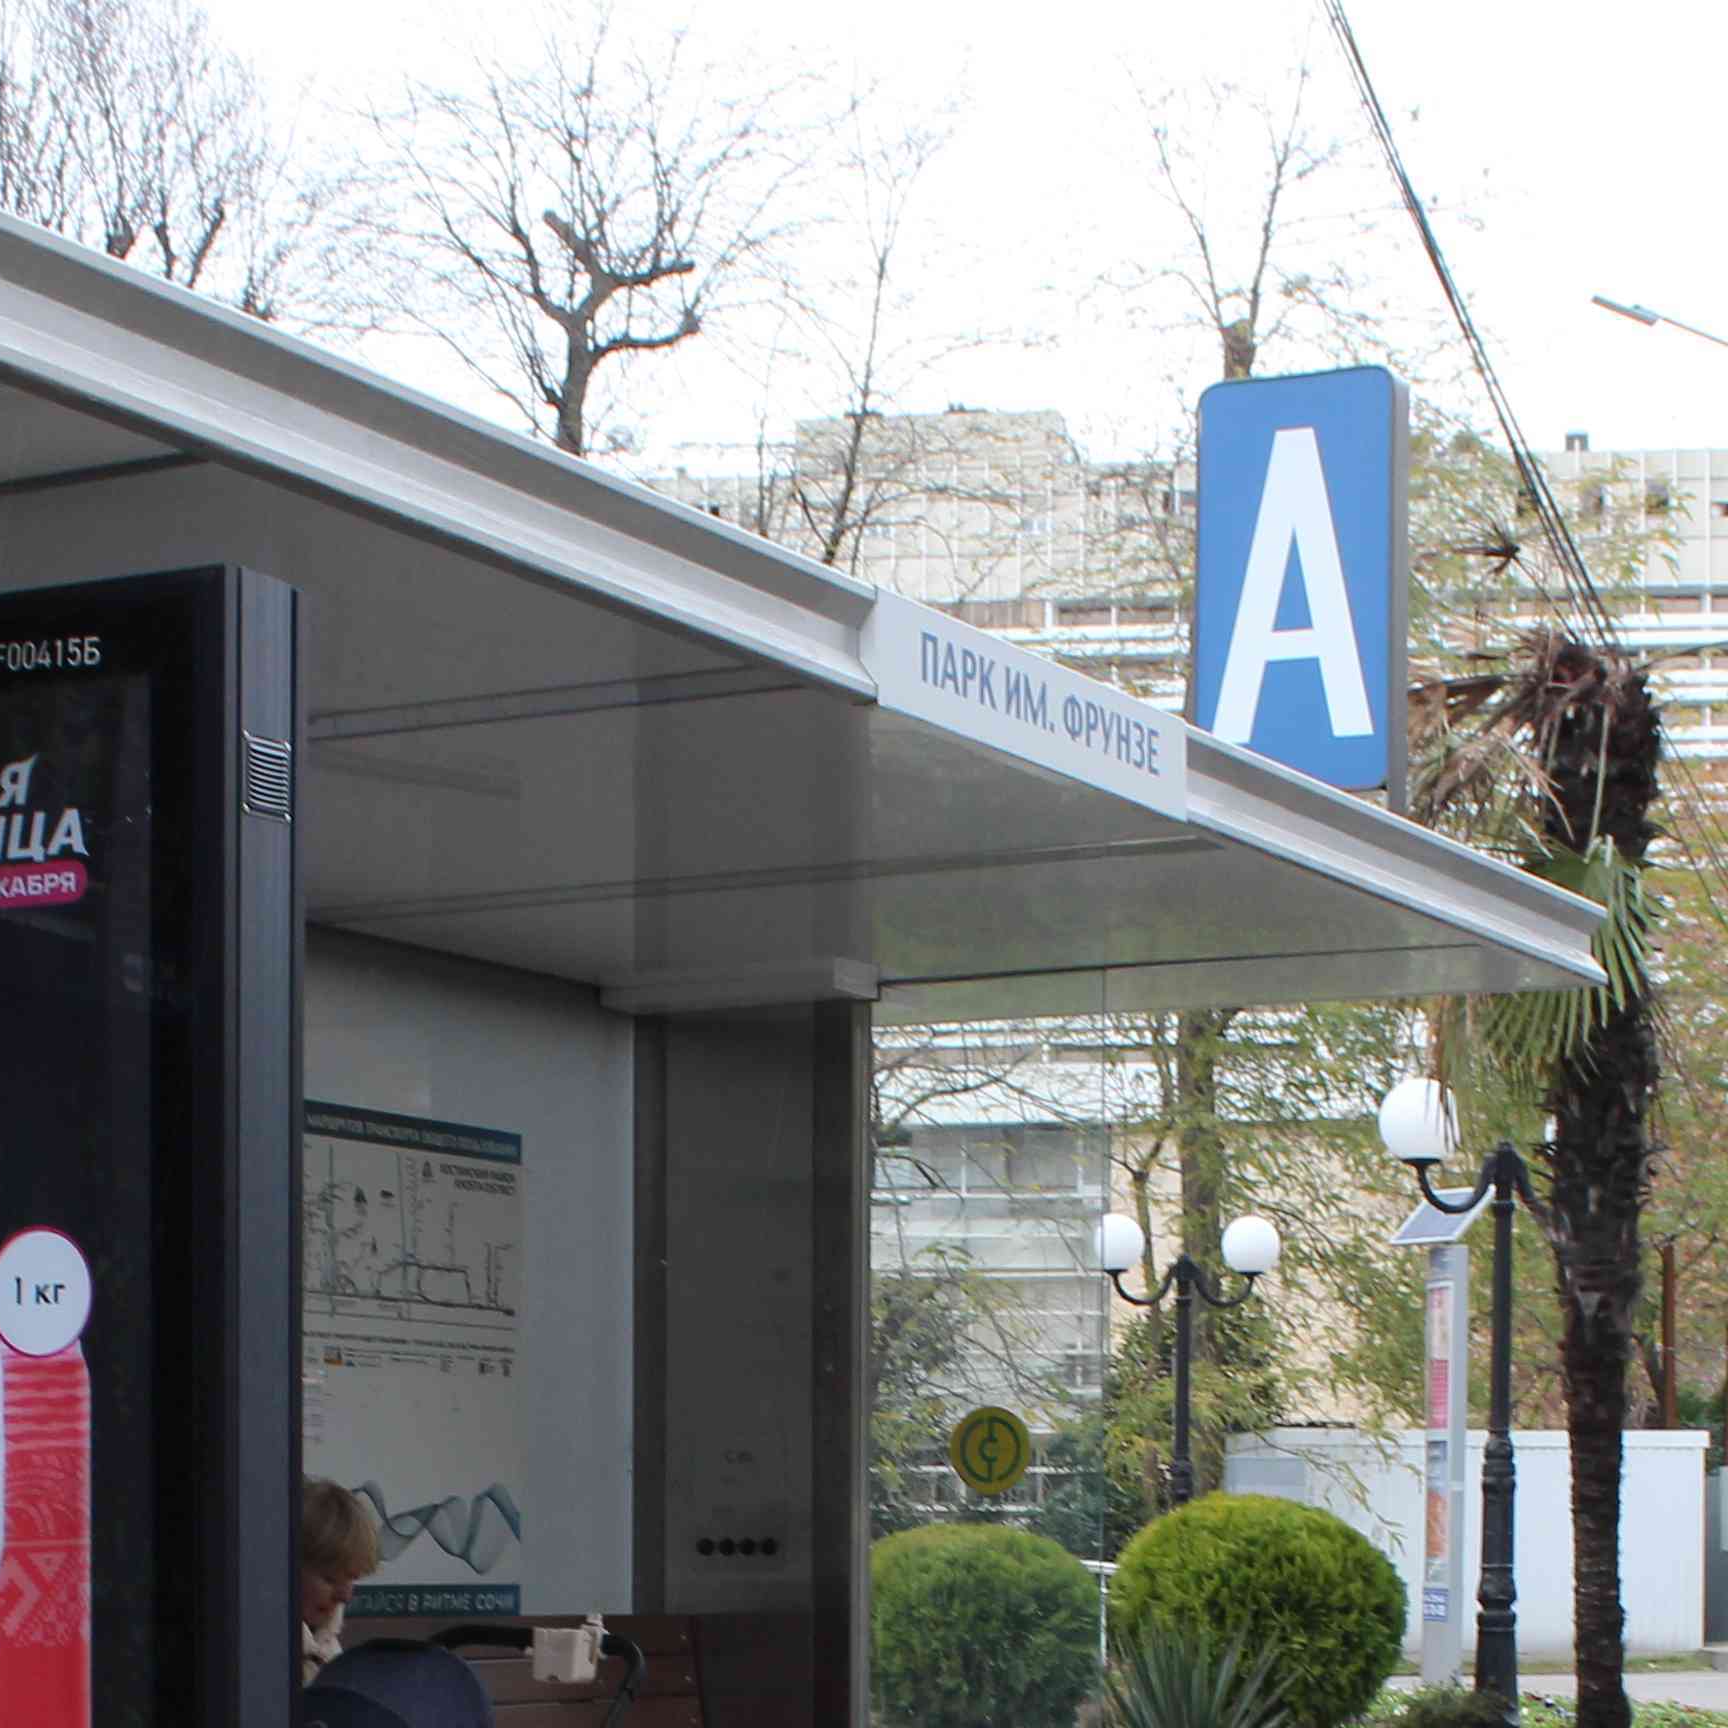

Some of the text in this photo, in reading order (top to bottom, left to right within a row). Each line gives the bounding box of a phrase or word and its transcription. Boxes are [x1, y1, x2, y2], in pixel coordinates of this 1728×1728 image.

[1212, 426, 1375, 742] А
[920, 631, 1160, 777] ПАРК ИМ. ФРУНЗЕ
[13, 1277, 67, 1305] 1 кг
